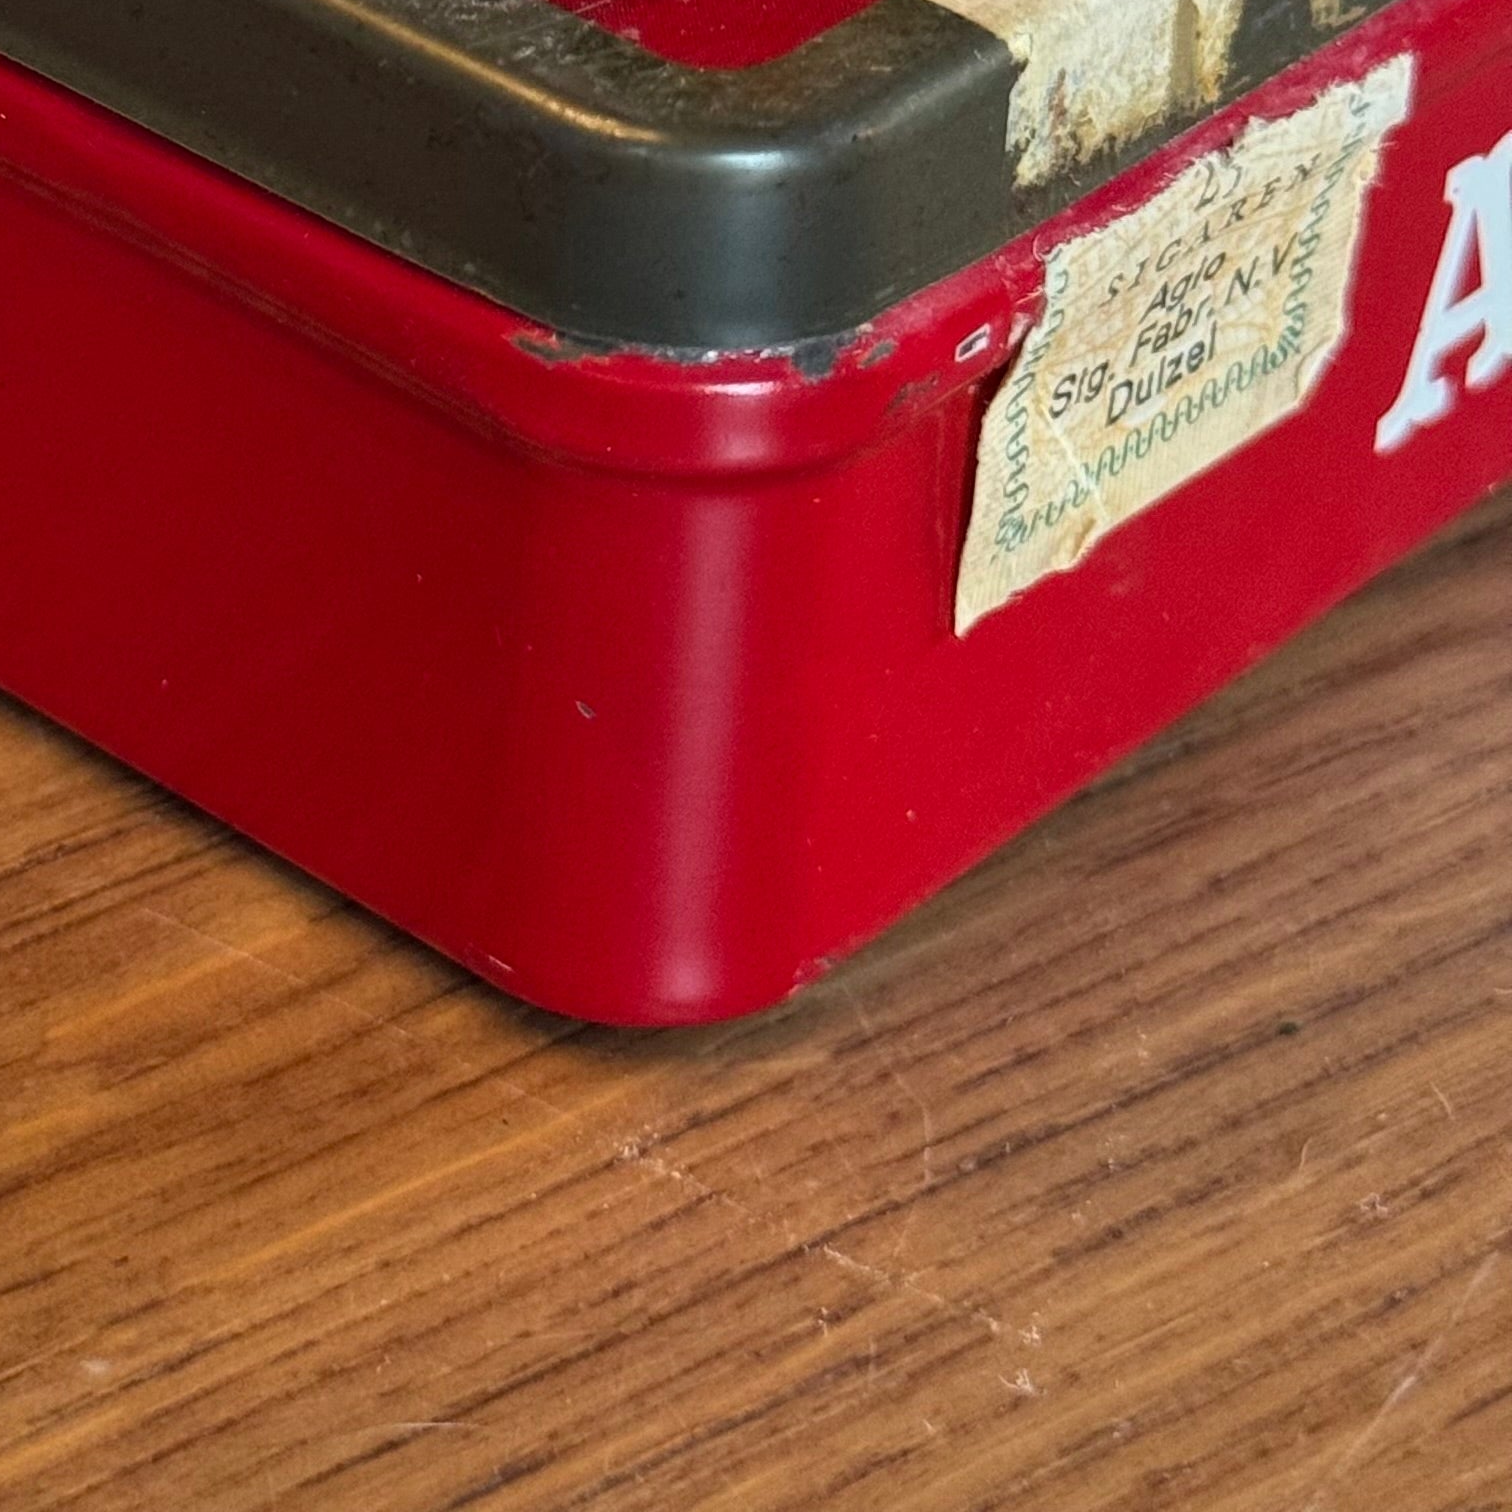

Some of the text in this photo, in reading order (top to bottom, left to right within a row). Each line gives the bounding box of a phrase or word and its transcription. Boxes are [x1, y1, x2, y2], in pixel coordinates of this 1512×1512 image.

[1097, 152, 1320, 308] SIGAREN
[1139, 252, 1226, 324] Agio
[1129, 296, 1215, 368] Fabr.
